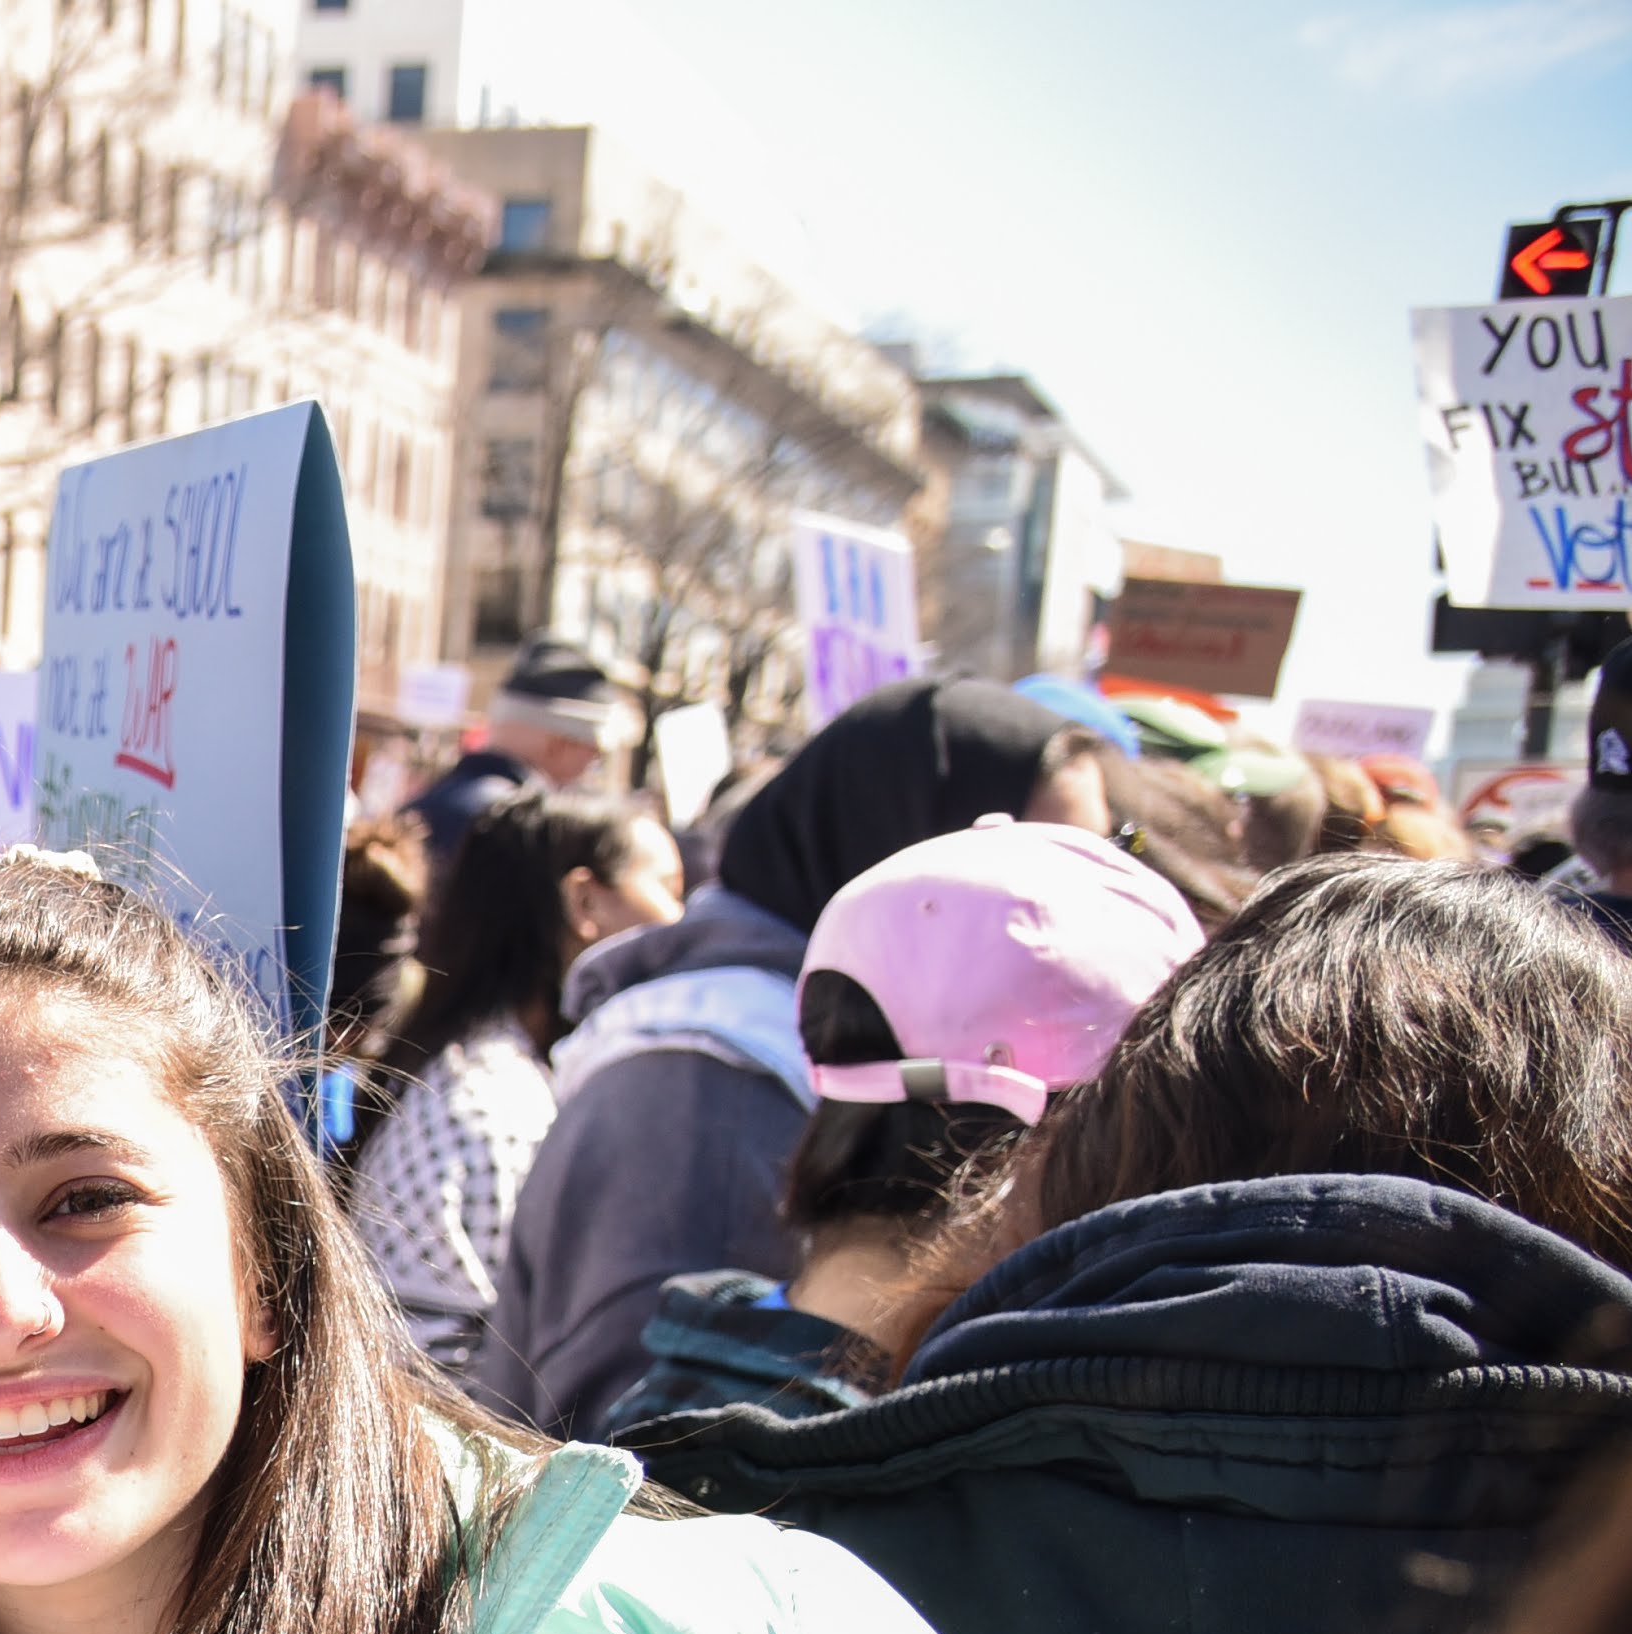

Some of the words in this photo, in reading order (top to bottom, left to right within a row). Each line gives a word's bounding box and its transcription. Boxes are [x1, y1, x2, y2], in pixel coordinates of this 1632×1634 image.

[1480, 310, 1610, 375] YOU
[1440, 404, 1536, 450] FIX
[161, 463, 249, 618] SCHOOL
[121, 634, 179, 772] WAR
